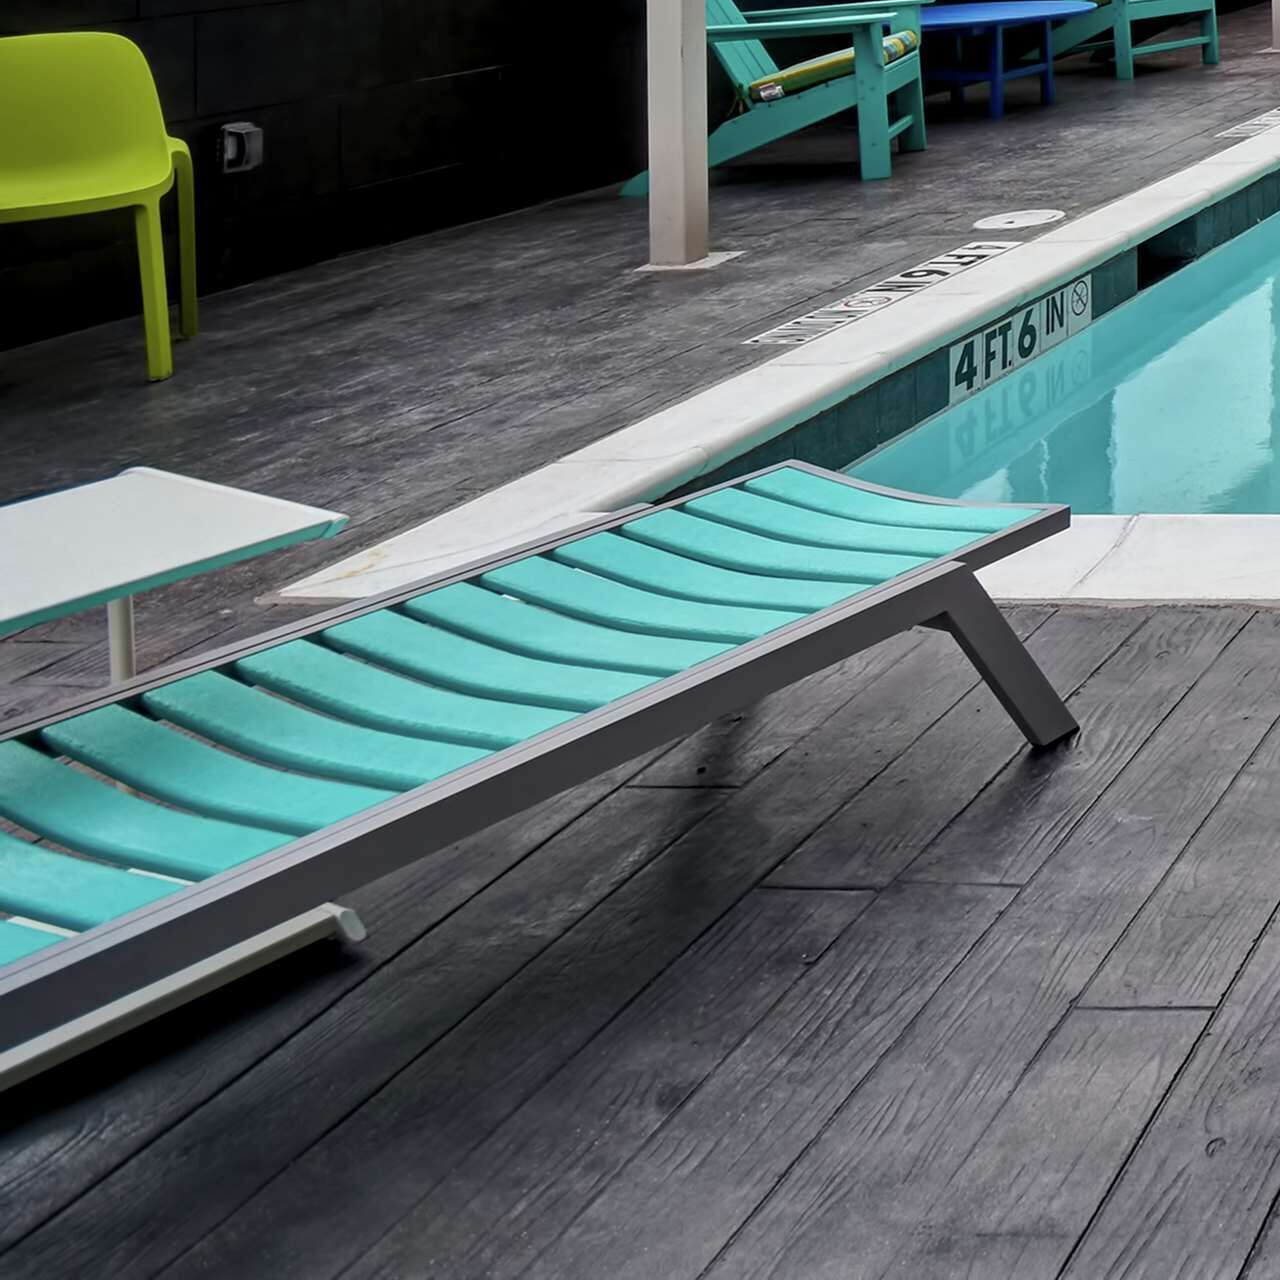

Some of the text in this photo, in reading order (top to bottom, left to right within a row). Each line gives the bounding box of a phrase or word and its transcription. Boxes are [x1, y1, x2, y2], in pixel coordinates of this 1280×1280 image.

[954, 340, 978, 391] 4
[1018, 308, 1037, 360] 6
[1046, 290, 1065, 336] IN
